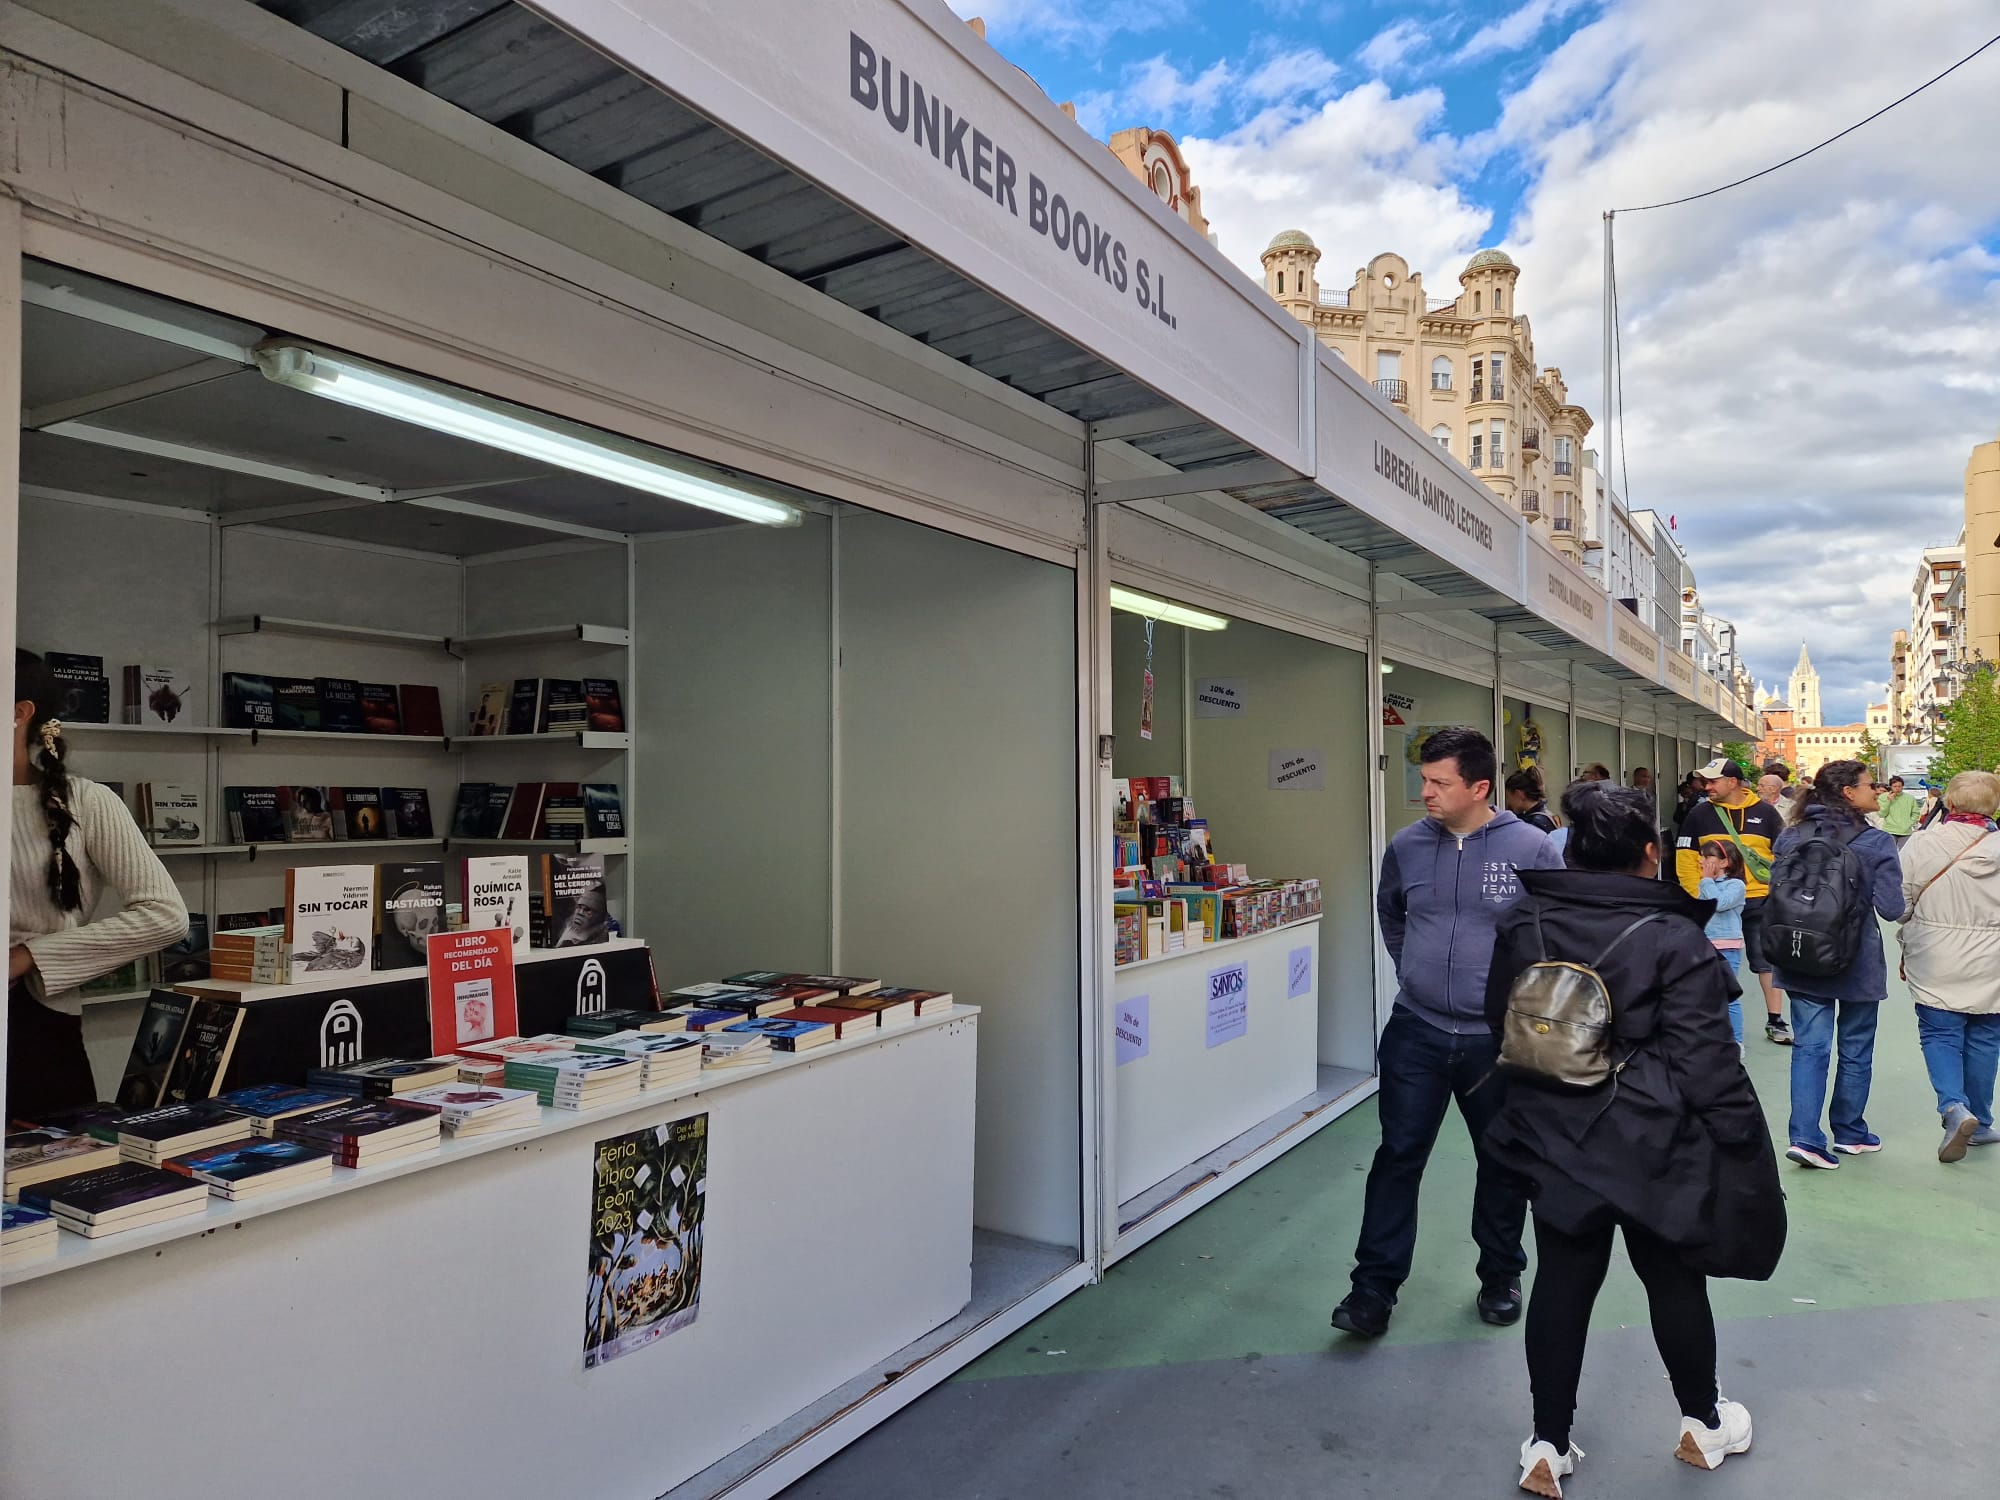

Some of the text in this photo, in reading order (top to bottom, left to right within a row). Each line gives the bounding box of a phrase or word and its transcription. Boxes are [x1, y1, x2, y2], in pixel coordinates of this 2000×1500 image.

[850, 30, 1177, 330] BUNKER BOOKS S.L.
[1374, 439, 1493, 551] LIBRERÍA SANTOS LECTORES
[1210, 684, 1235, 697] 10% de
[1199, 694, 1241, 710] DESCUENTO
[254, 705, 273, 715] VISTO
[1281, 757, 1305, 770] 10% de
[1277, 763, 1317, 783] DESCUENTO
[553, 871, 602, 881] LAS LÁGRIMAS
[1482, 873, 1518, 883] SURF
[473, 881, 522, 896] QUÍMICA
[554, 880, 591, 889] DEL CERDO
[1482, 884, 1517, 894] TEAM
[554, 888, 586, 896] TRUFERO
[298, 900, 368, 913] SIN TOCAR
[385, 897, 443, 910] BASTARDO
[473, 895, 505, 907] ROSA
[455, 935, 487, 948] LIBRO
[443, 946, 499, 960] RECOMENDADO
[451, 955, 493, 972] DEL DÍA
[1212, 971, 1243, 998] SANTOS
[456, 991, 489, 1001] INHUMANOS
[1132, 1018, 1140, 1028] de
[1115, 1026, 1142, 1047] DESCUENTO
[600, 1142, 636, 1161] Feria
[598, 1166, 635, 1188] Libro
[597, 1188, 635, 1212] León
[595, 1210, 632, 1236] 2023
